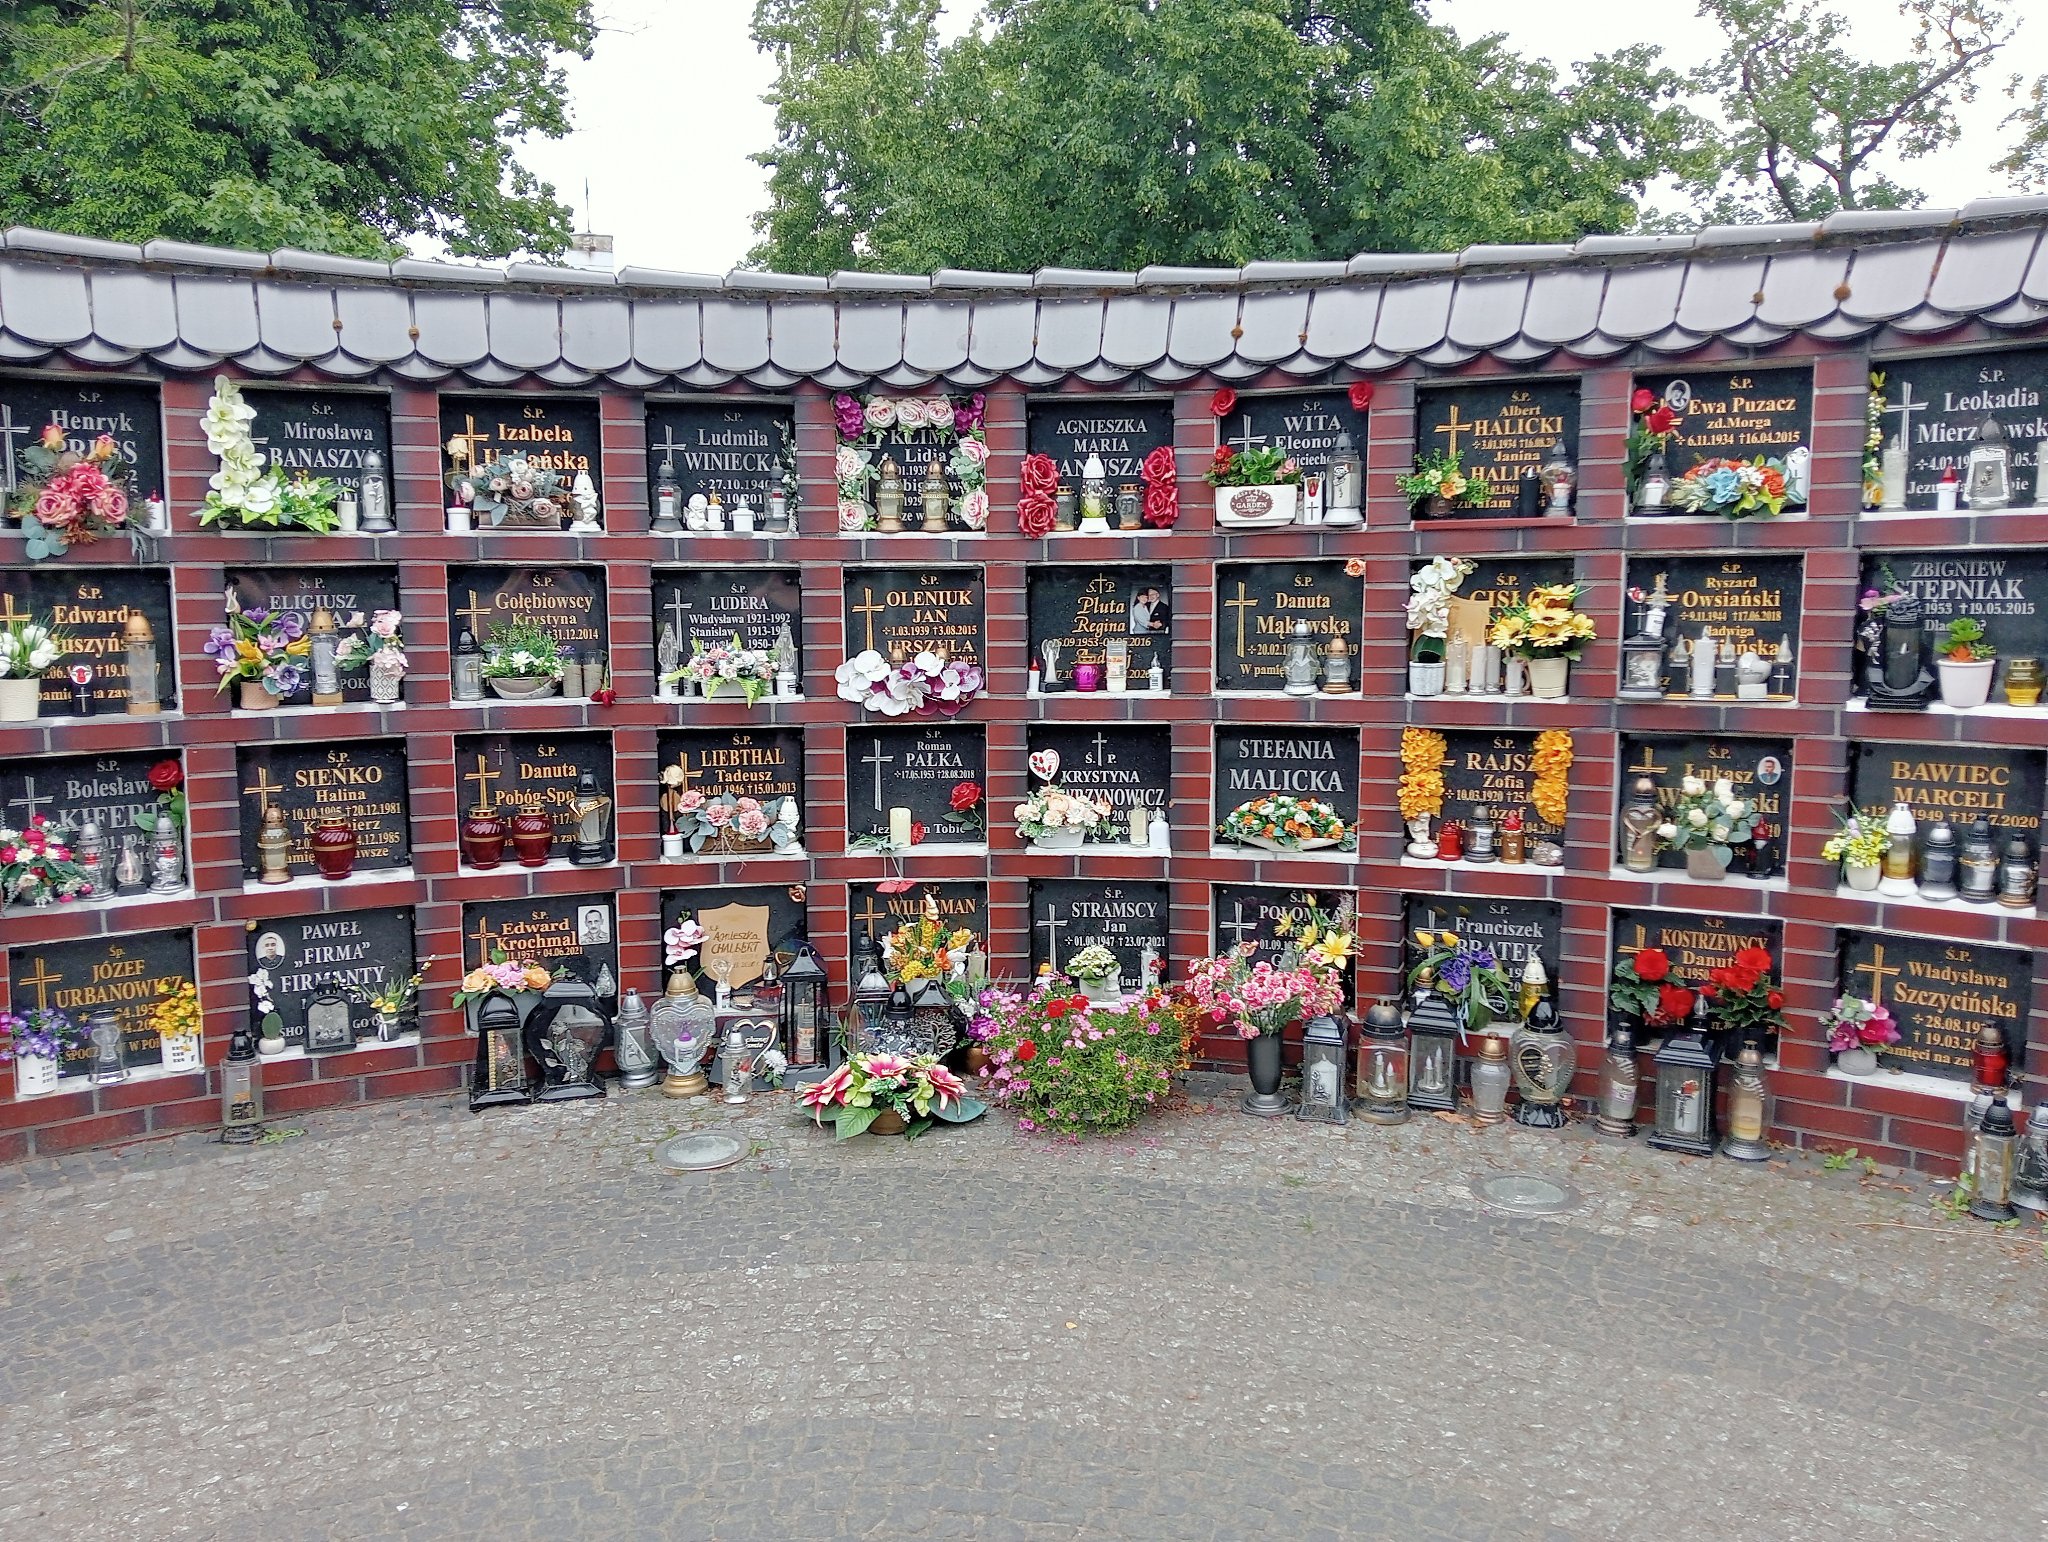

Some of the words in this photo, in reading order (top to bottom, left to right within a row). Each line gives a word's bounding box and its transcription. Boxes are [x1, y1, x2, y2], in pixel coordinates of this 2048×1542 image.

[1729, 376, 1754, 389] Ś.P.
[1978, 367, 2005, 383] Ś.P.
[1687, 400, 1727, 415] Ewa
[1731, 397, 1796, 413] Puzacz
[1943, 388, 2040, 412] Leokadia
[523, 405, 546, 418] Ś.P.
[1499, 405, 1541, 417] Albert
[51, 409, 134, 436] Henryk
[1056, 418, 1148, 435] AGNIESZKA
[1284, 415, 1342, 433] WITA
[1474, 416, 1563, 437] HALICKI
[498, 424, 573, 442] Izabela
[1074, 437, 1130, 453] MARIA
[1494, 453, 1540, 464] Janina
[1910, 560, 2007, 578] ZBIGNIEW
[533, 574, 554, 587] Ś.P.
[921, 574, 940, 586] Ś.P.
[1294, 573, 1313, 587] Ś.P.
[1496, 573, 1520, 586] Ś.P.
[1706, 576, 1757, 591] Ryszard
[78, 584, 103, 599] Ś.P.
[731, 583, 747, 594] Ś.P.
[270, 595, 357, 610] ELIGIUSZ
[495, 592, 593, 613] Gołębiowscy
[710, 596, 769, 611] LUDERA
[887, 590, 973, 607] OLENIUK
[1077, 596, 1125, 615] Pluta
[1275, 592, 1331, 609] Danuta
[1681, 591, 1781, 608] Owsiański
[52, 604, 128, 625] Edward
[912, 608, 948, 623] JAN
[1970, 602, 2035, 615] 19.05.2015
[512, 613, 577, 627] Krystyna
[689, 613, 744, 627] Władysława
[747, 613, 790, 625] 1921-1992
[1072, 616, 1126, 638] Regina
[1255, 615, 1350, 639] Mąkwska
[553, 627, 599, 640] 31.12.2014
[892, 625, 930, 637] 1.03.1939
[939, 624, 978, 636] 3.08.2015
[732, 732, 753, 746] Ś.P.
[917, 742, 952, 751] Roman
[1494, 737, 1515, 750] Ś.P.
[327, 751, 350, 763] Ś.P.
[538, 745, 557, 757] Ś.P.
[1239, 739, 1335, 760] STEFANIA
[701, 749, 785, 767] LIEBTHAL
[906, 753, 963, 767] PAŁKA
[1107, 754, 1117, 764] P.
[295, 763, 383, 788] SIEŃKO
[520, 763, 578, 780] Danuta
[715, 769, 772, 783] Tadeusz
[1062, 770, 1140, 783] KRYSTYNA
[1891, 760, 2011, 787] BAWIEC
[1229, 768, 1344, 792] MALICKA
[1483, 773, 1525, 788] Zofia
[66, 777, 150, 800] Bolesław
[315, 788, 367, 803] Halina
[753, 782, 796, 795] 15.01.2013
[1893, 786, 2006, 810] MARCELI
[352, 802, 402, 818] 20.12.1981
[1104, 887, 1124, 899] Ś.P.
[532, 910, 550, 921] Ś.P.
[1071, 902, 1158, 918] STRAMSCY
[302, 921, 362, 940] PAWEŁ
[502, 918, 570, 936] Edward
[1102, 919, 1127, 933] Jan
[1455, 917, 1543, 938] Franciszek
[496, 931, 577, 952] Krochmal
[1074, 936, 1114, 947] 01.08.1947
[544, 946, 583, 959] 04.06.2021
[1946, 946, 1972, 963] Ś.P.
[92, 960, 145, 984] JÓZEF
[1907, 962, 2009, 989] Władysława
[1894, 981, 2018, 1019] Szczycińska
[353, 1017, 369, 1029] GO
[1934, 1053, 1951, 1064] na
